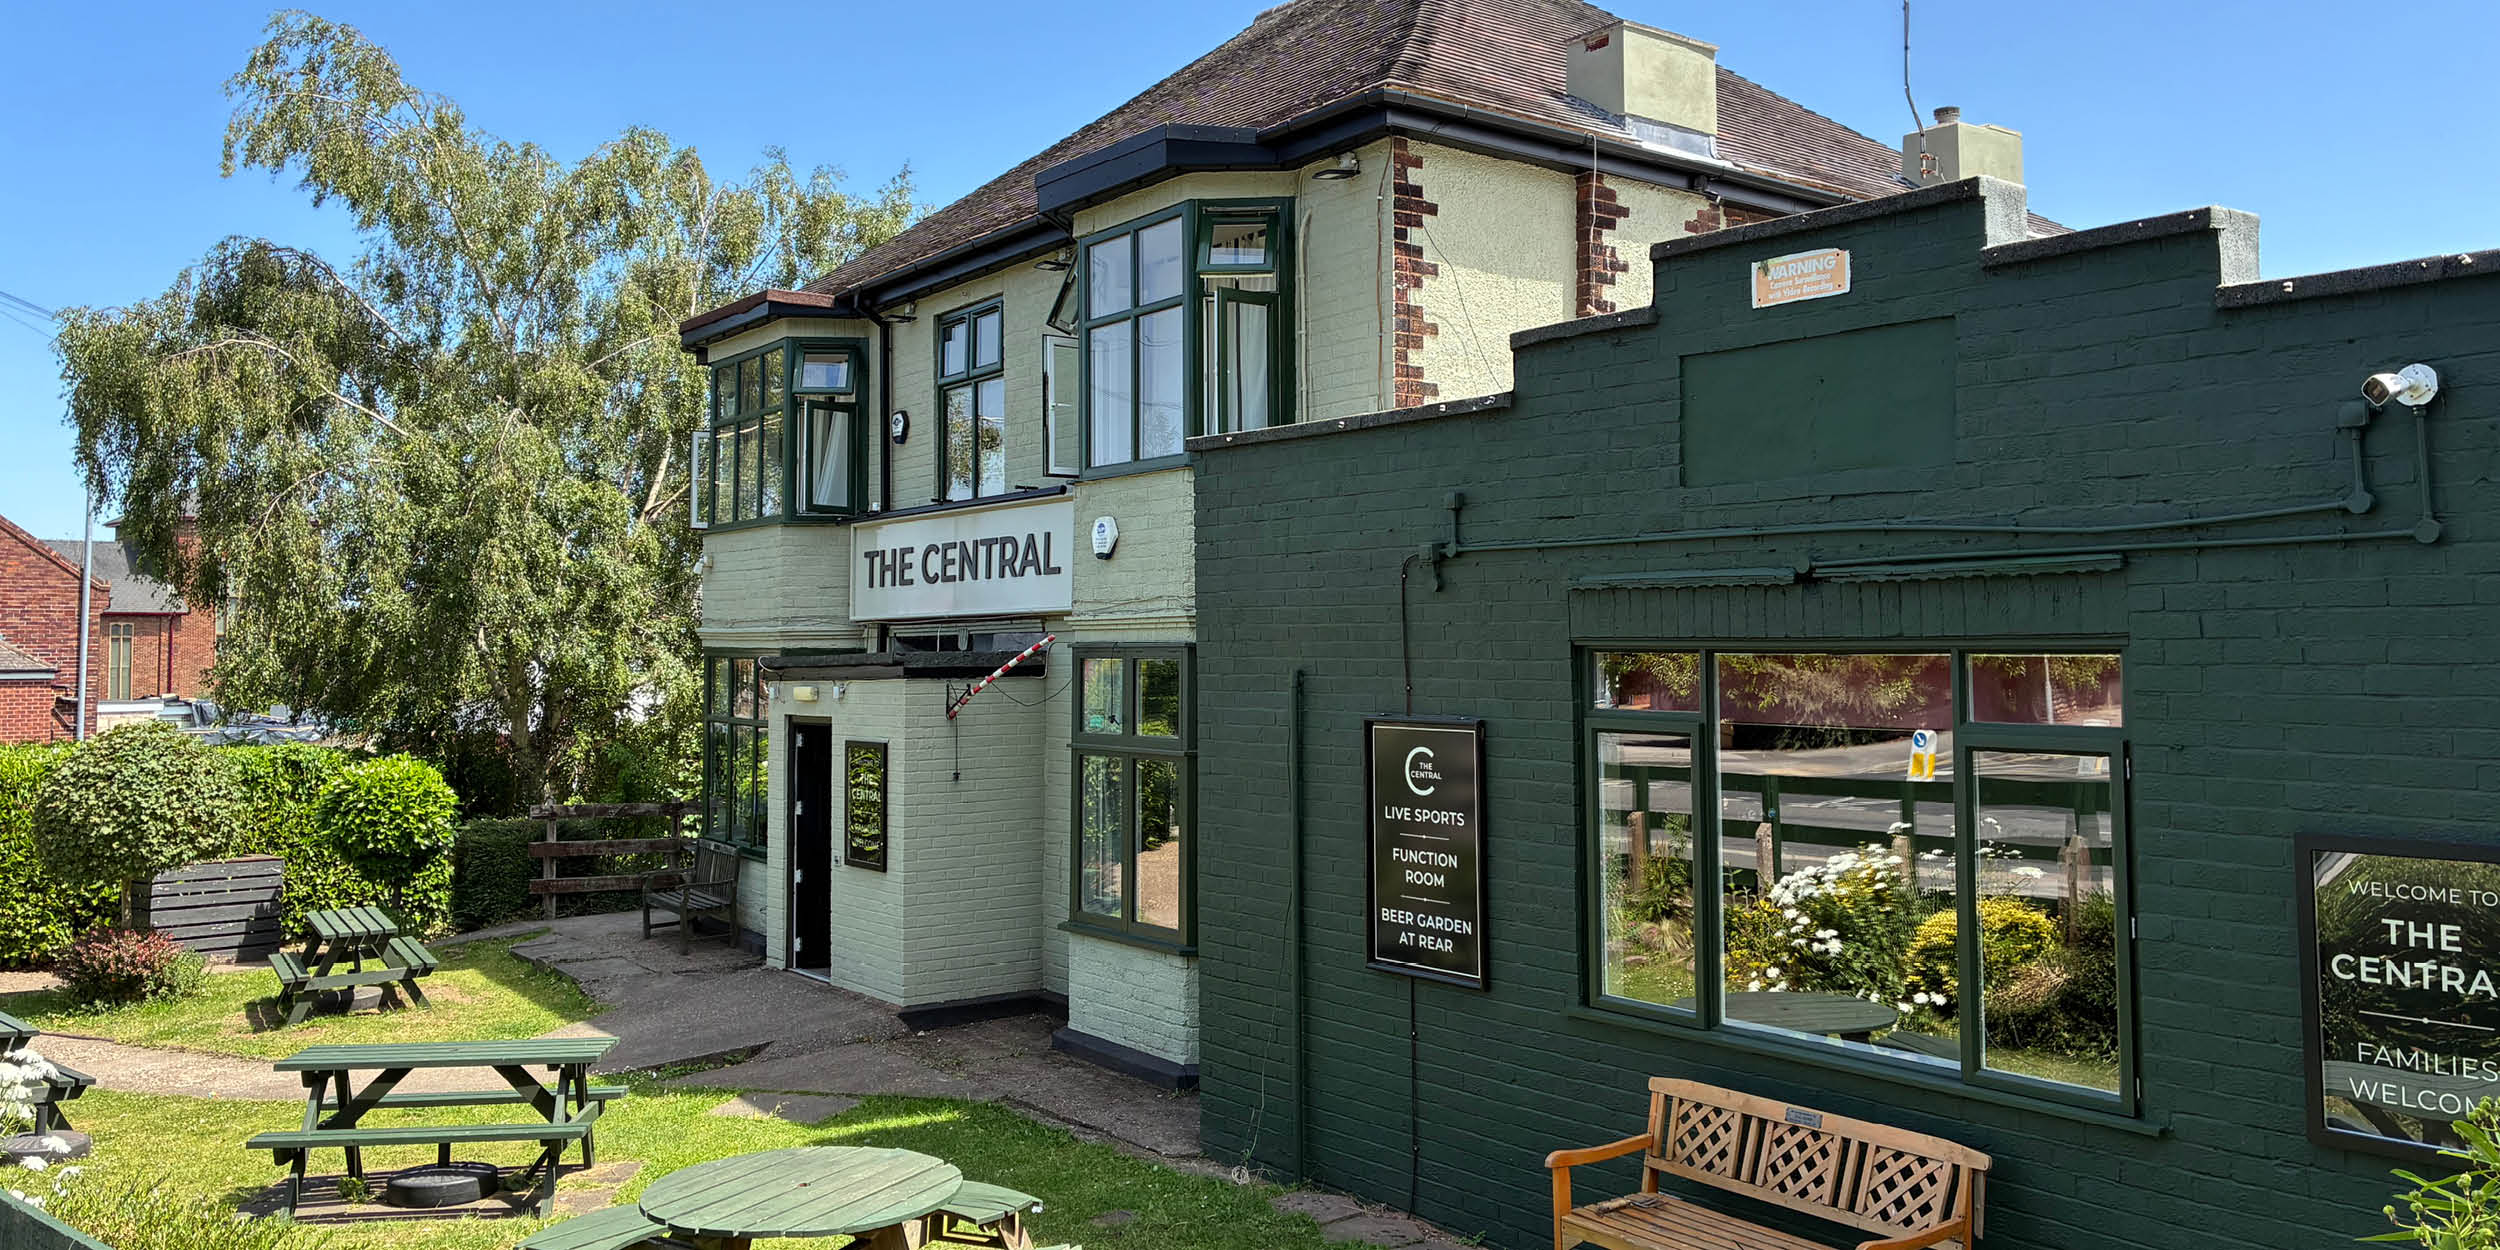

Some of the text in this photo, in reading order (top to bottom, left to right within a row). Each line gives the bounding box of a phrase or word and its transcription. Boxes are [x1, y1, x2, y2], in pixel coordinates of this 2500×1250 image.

[1767, 255, 1836, 280] WARNING
[864, 531, 1061, 588] THE CENTRAL
[1410, 770, 1442, 780] CENTRAL
[1419, 762, 1433, 771] THE
[1384, 806, 1465, 826] LIVE SPORTS
[1393, 848, 1458, 869] FUNCTION
[1405, 869, 1445, 887] ROOM
[2348, 878, 2499, 907] WELCOME TO
[1382, 907, 1472, 935] BEER GARDEN
[1399, 932, 1453, 953] AT REAR
[2381, 918, 2462, 952] THE
[2331, 953, 2499, 998] CENTRA
[2357, 1042, 2499, 1082] FAMILIES
[2349, 1077, 2475, 1117] WELCO
